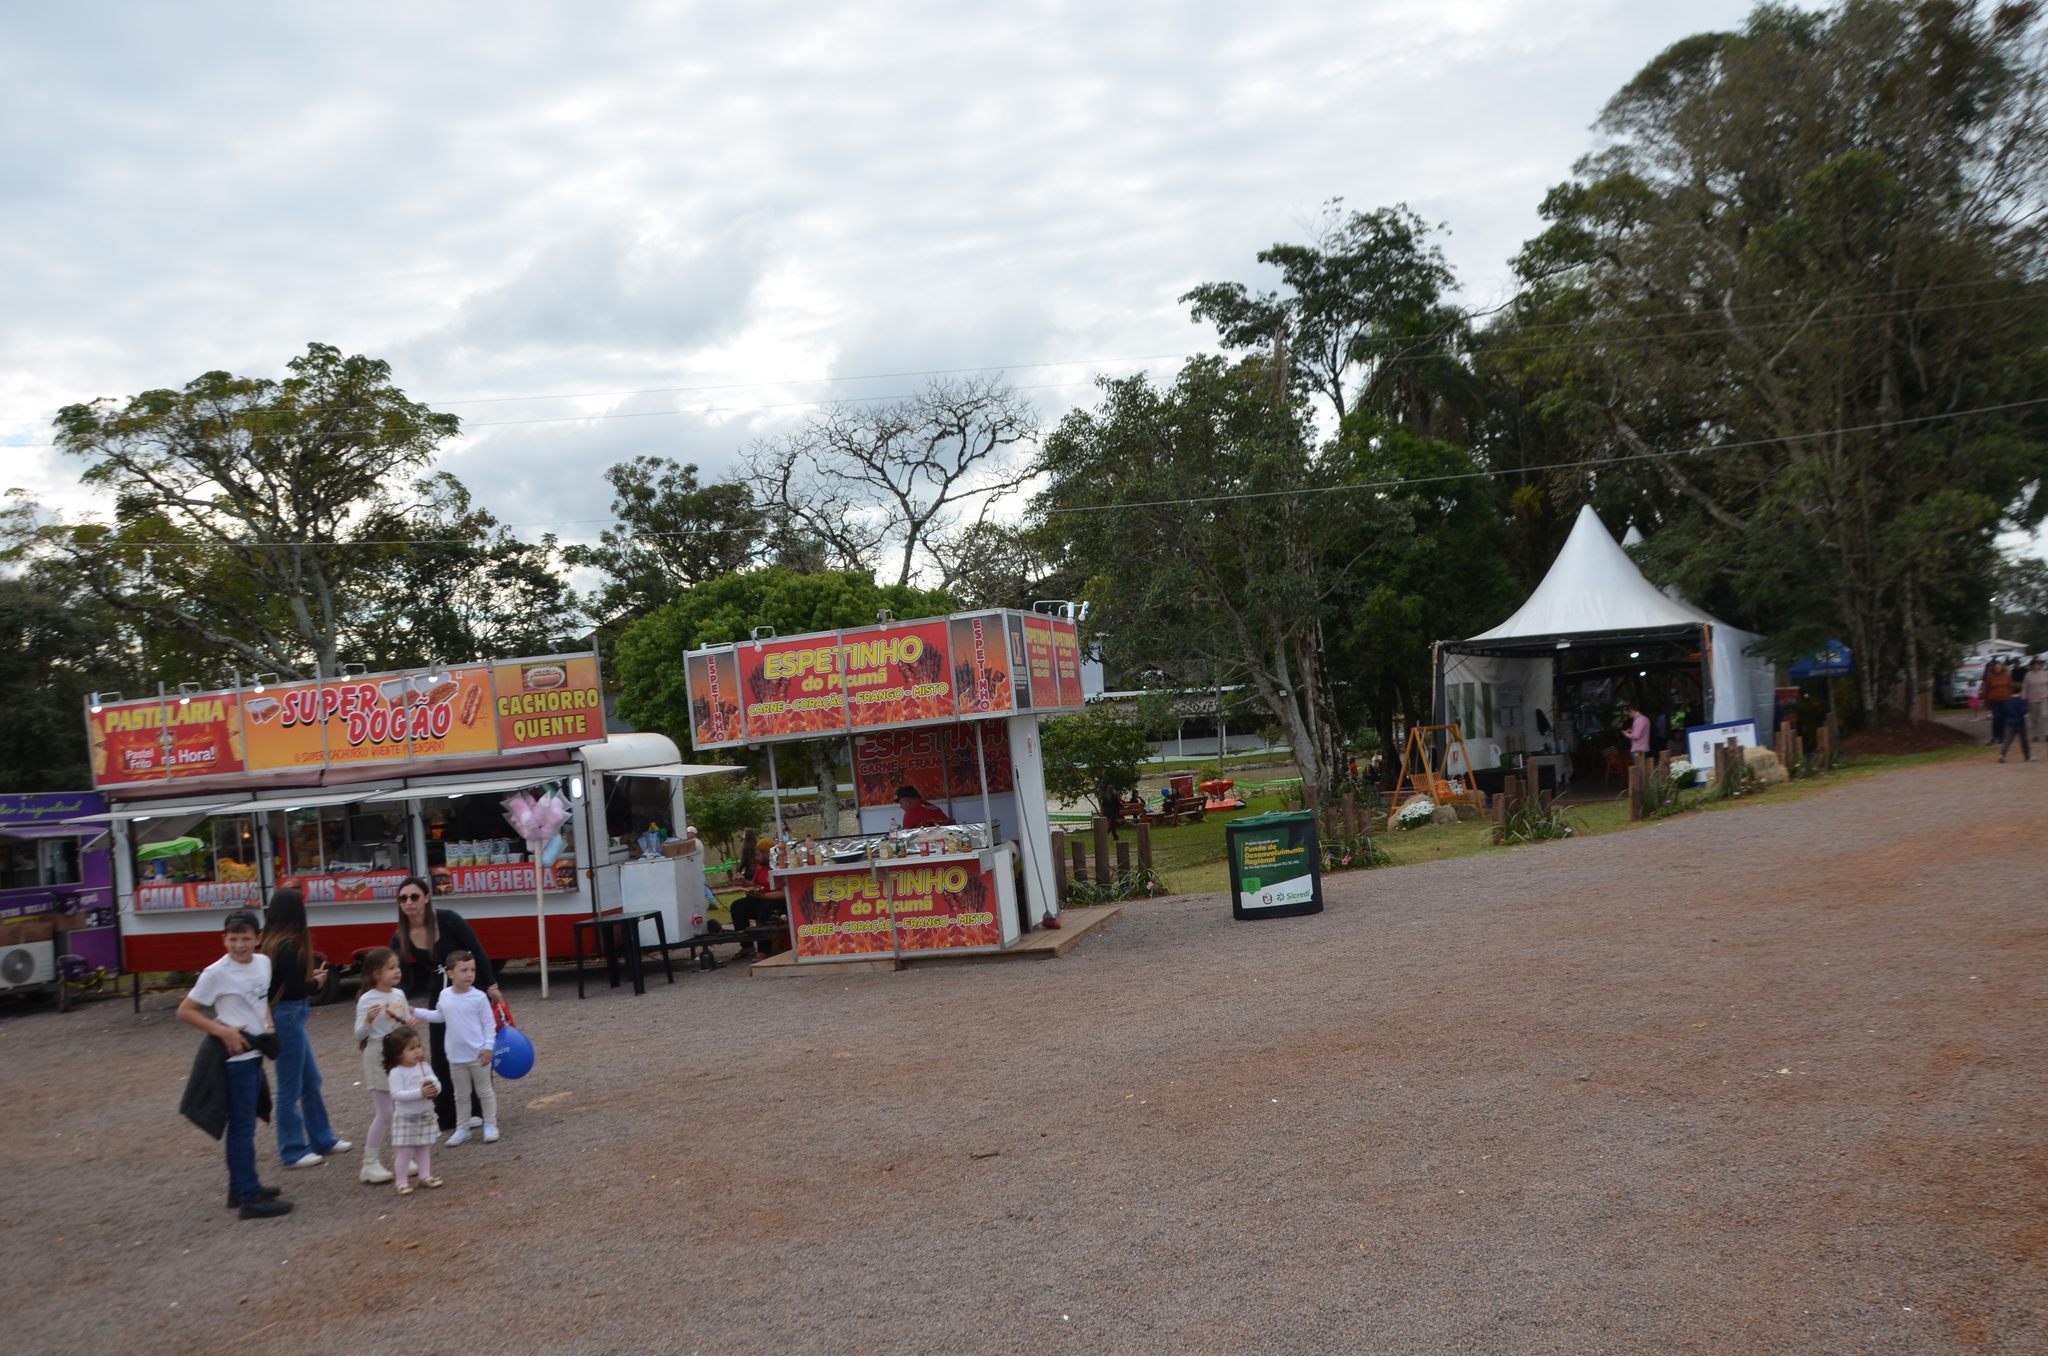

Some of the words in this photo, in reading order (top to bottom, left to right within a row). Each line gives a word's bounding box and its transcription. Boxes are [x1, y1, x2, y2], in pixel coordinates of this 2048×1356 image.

[764, 636, 923, 679] ESPETINHO
[972, 618, 991, 711] ESPETINHO
[801, 675, 824, 691] do
[281, 684, 379, 726] SUPER
[497, 688, 600, 716] CACHORRO
[707, 655, 725, 742] ESPETINHO
[748, 702, 784, 716] CARNE
[792, 693, 846, 713] CORAÇÃO
[856, 688, 903, 704] FRANGO
[912, 682, 949, 697] MISTO
[105, 699, 225, 733] PASTELARIA
[348, 696, 453, 745] DOGÃO
[513, 714, 587, 742] QUENTE
[858, 719, 1009, 760] ESPETINH
[178, 745, 216, 763] Hora!
[1245, 847, 1304, 858] Desenvolvimento
[1245, 856, 1275, 865] Regional
[452, 867, 555, 893] LANCHERA
[813, 866, 968, 902] ESPETINHO
[139, 886, 184, 909] CAIXA
[851, 901, 872, 915] do
[1286, 891, 1310, 899] Sicredi
[798, 923, 834, 937] CARNE
[842, 917, 893, 935] CORAÇÃO
[903, 915, 949, 929] FRANGO
[958, 912, 993, 925] MISTO
